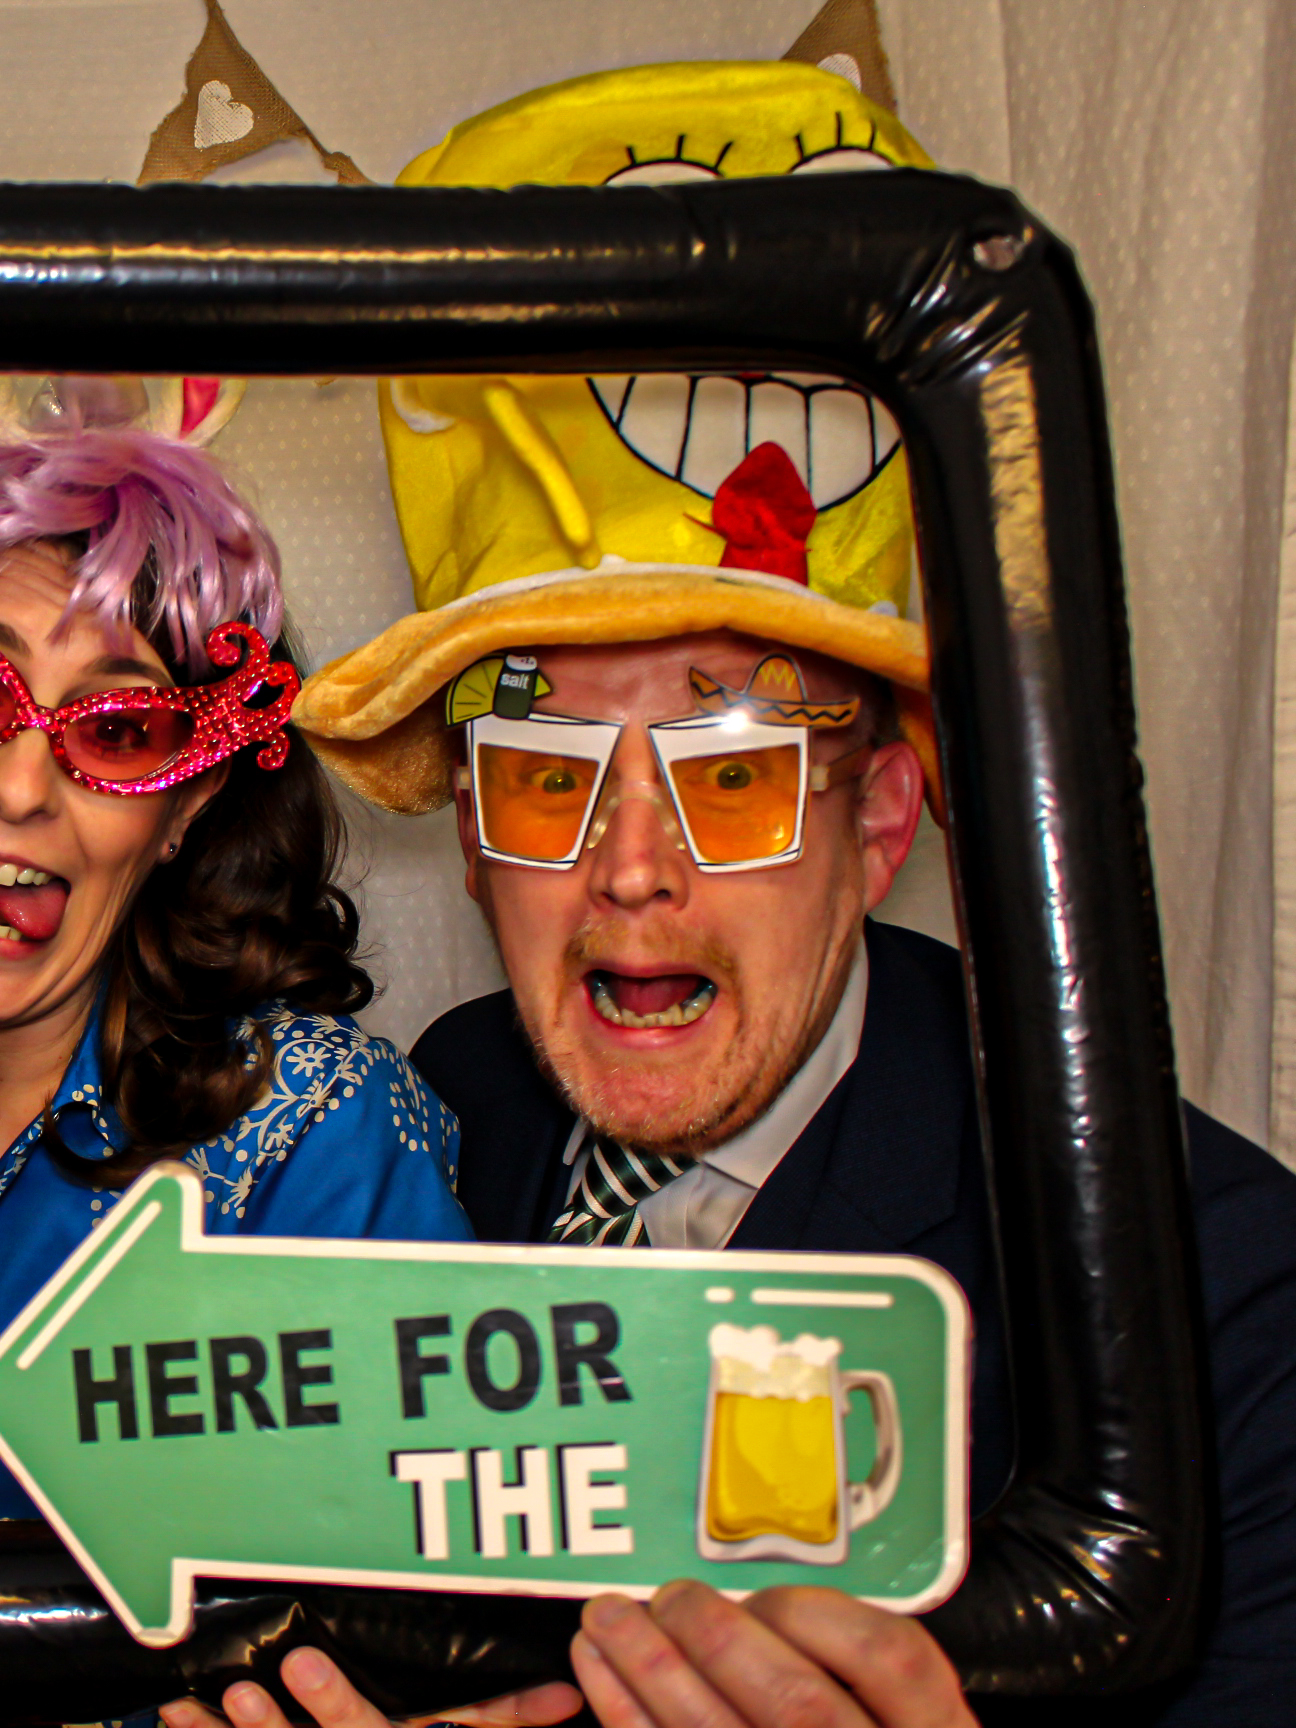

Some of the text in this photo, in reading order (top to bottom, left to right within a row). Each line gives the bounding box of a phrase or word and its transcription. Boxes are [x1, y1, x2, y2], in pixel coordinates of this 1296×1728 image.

[500, 673, 530, 690] salt
[72, 1301, 633, 1443] HERE FOR
[389, 1441, 634, 1560] THE
